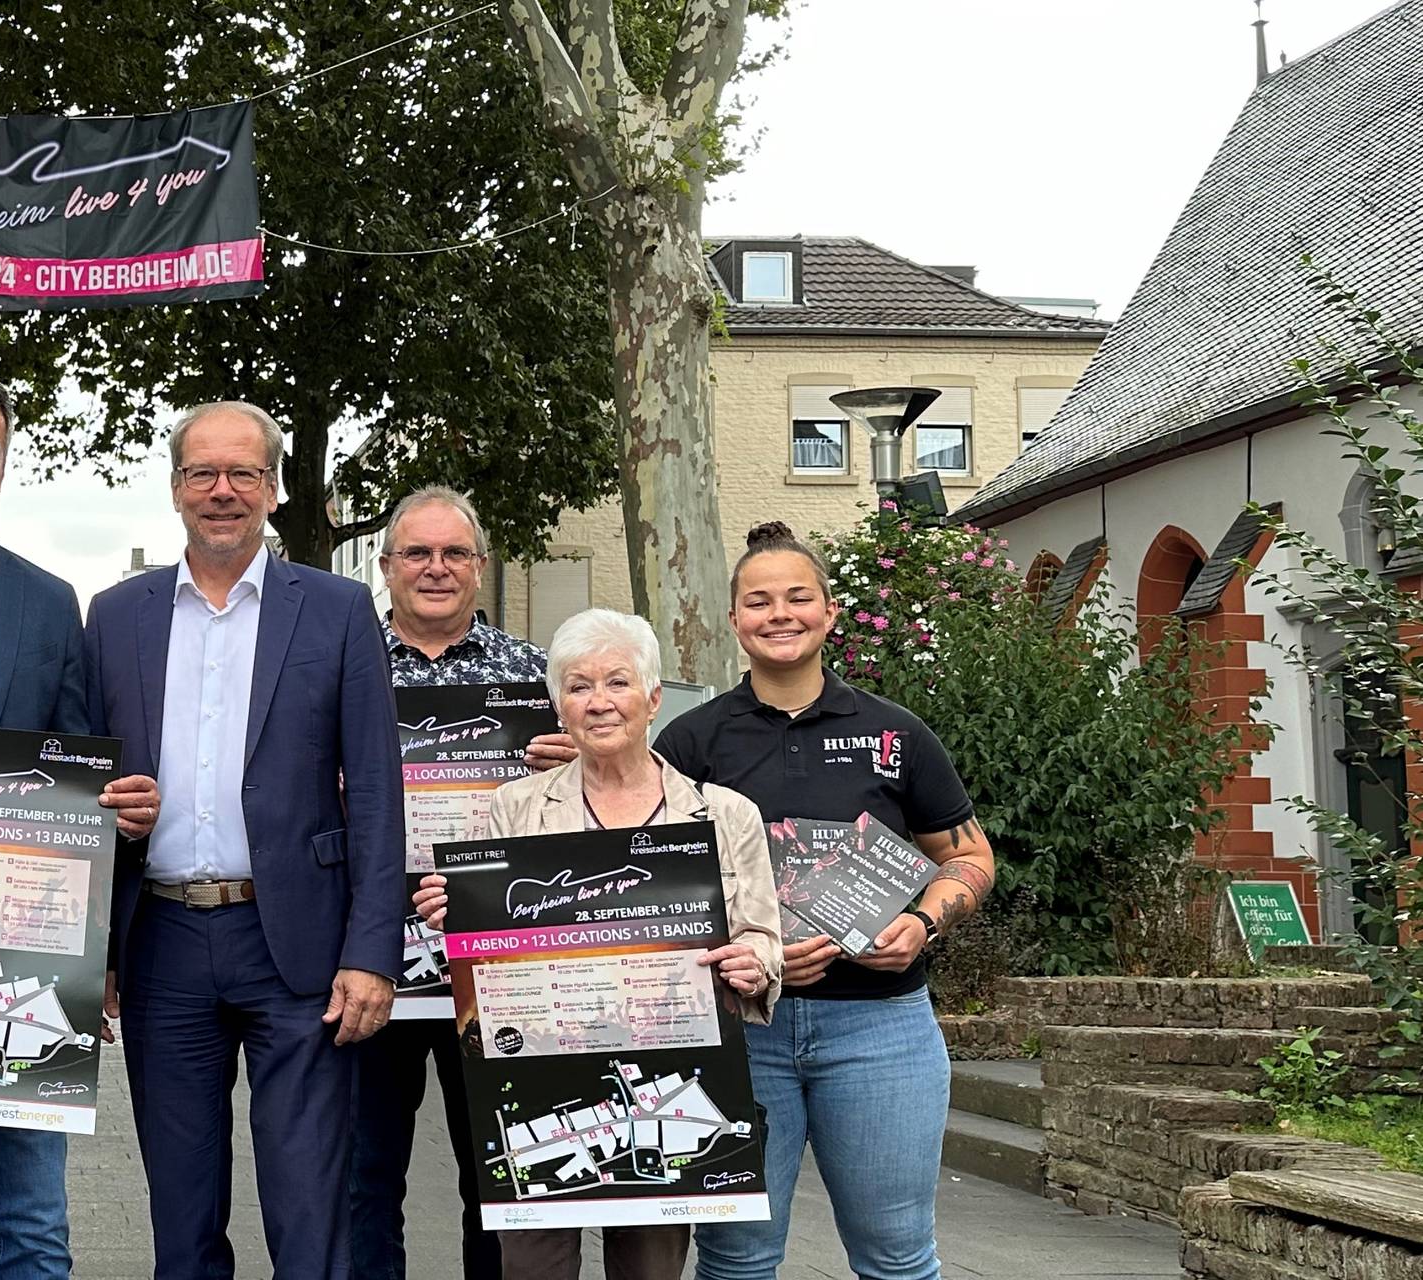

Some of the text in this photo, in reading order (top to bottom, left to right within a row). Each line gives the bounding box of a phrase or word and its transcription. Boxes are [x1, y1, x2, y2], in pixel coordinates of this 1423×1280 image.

[64, 186, 120, 219] live
[127, 177, 148, 206] 4
[155, 167, 207, 205] you
[36, 248, 233, 291] CITY.BERGHEIM.DE
[517, 700, 549, 708] Bergheim
[400, 737, 436, 758] gheim
[439, 731, 458, 743] live
[461, 728, 468, 739] 4
[76, 755, 113, 767] Bergheim
[436, 749, 524, 760] 28. SEPTEMBER 19
[405, 765, 533, 780] 2 LOCATIONS 13 BAN
[8, 782, 17, 793] 4
[64, 813, 76, 823] 19
[78, 813, 102, 826] UHR
[35, 831, 50, 843] 13
[53, 832, 100, 847] BANDS
[669, 842, 708, 854] Bergheim
[812, 842, 829, 851] Big
[445, 851, 483, 863] EINTRITT
[786, 856, 801, 864] Die
[870, 844, 884, 861] Big
[885, 854, 905, 872] Band
[838, 842, 915, 896] Die ersten 40 Jahre!
[853, 881, 874, 897] 2024
[858, 874, 891, 898] September
[512, 895, 574, 920] Bergheim
[577, 885, 602, 902] live
[604, 883, 614, 894] 4
[1239, 895, 1279, 907] Ich bin
[575, 901, 710, 922] 28. SEPTEMBER 19 UHR
[1274, 909, 1293, 921] für
[461, 921, 713, 952] 1 ABEND 12 LOCATIONS 13 BANDS
[661, 1204, 737, 1217] westenergie
